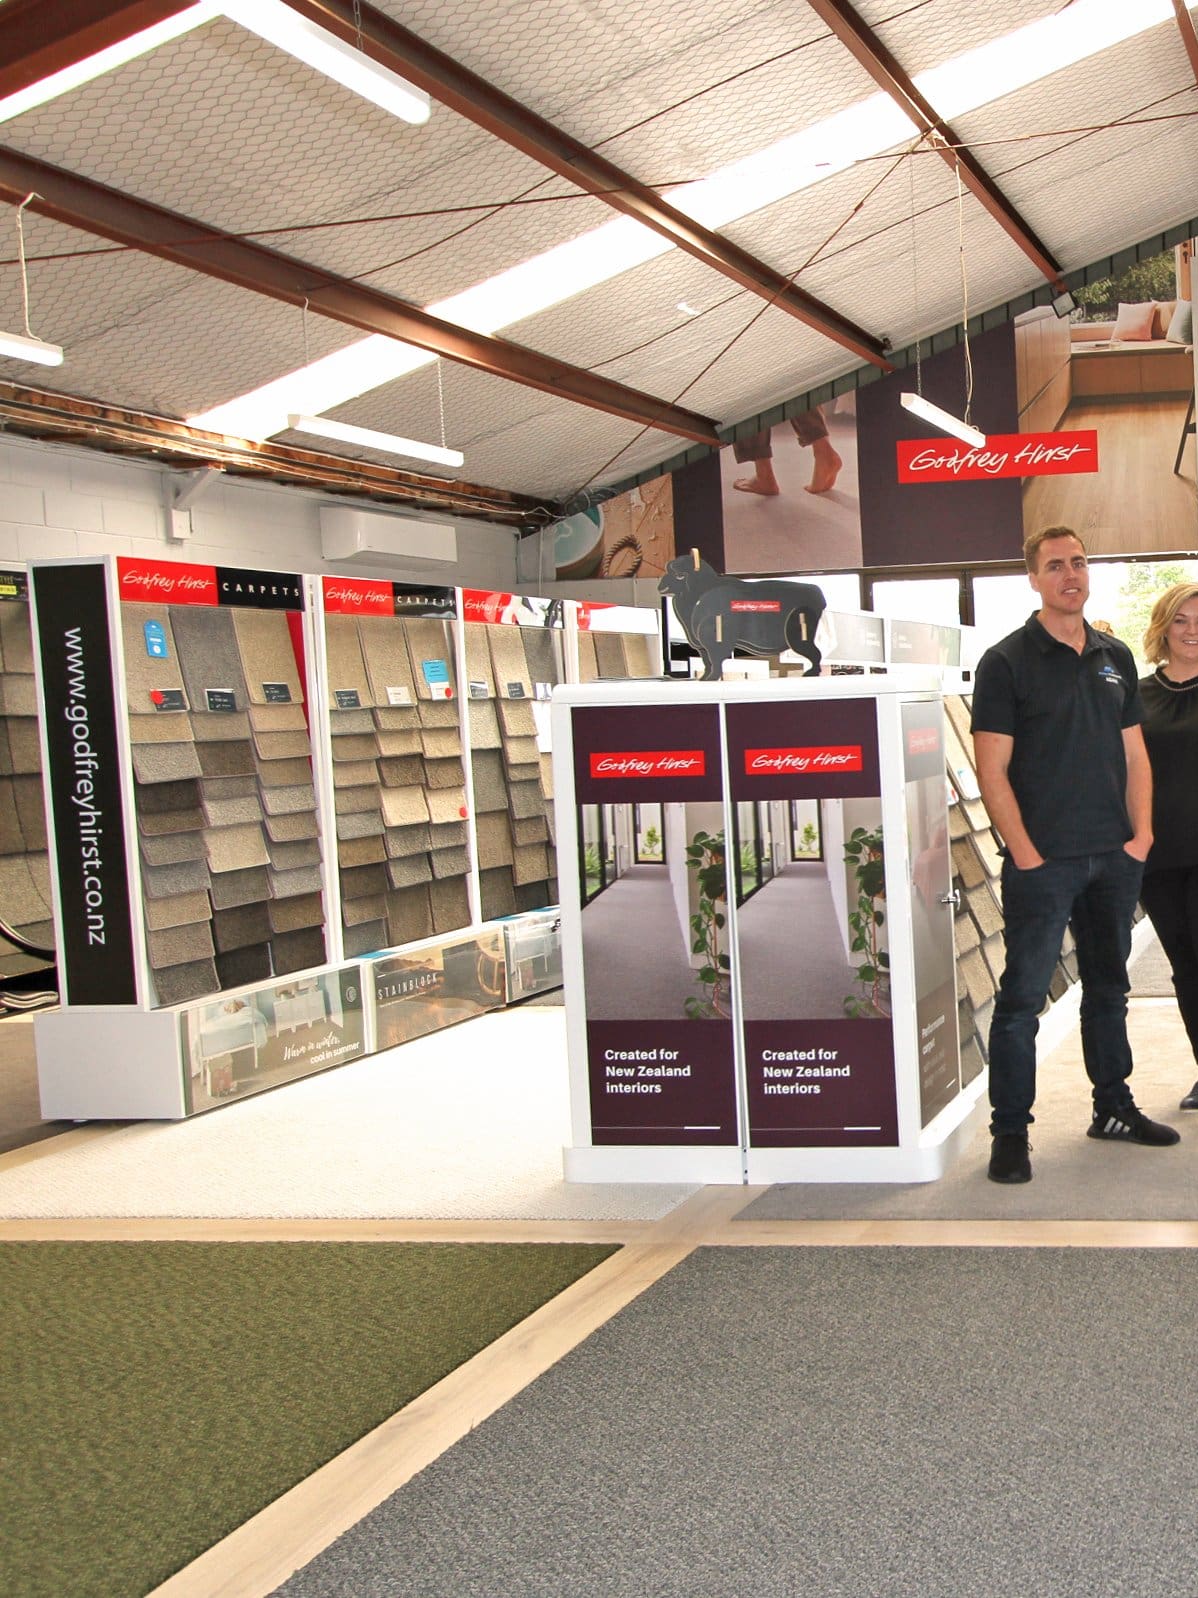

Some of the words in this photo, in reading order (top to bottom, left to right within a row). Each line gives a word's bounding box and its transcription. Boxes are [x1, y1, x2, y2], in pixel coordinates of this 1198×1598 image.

[908, 448, 1009, 475] Godfrey
[1014, 442, 1091, 465] Hirst
[122, 570, 175, 593] Godfrey
[177, 575, 215, 590] Hirst
[222, 582, 300, 597] CARPETS
[325, 586, 363, 606] Godfrey
[364, 589, 392, 603] Hirst
[397, 596, 454, 607] CARPETS
[597, 757, 653, 774] Godfrey
[656, 756, 700, 770] Hirst
[752, 754, 809, 770] Godfrey
[812, 752, 858, 766] Hirst
[64, 626, 106, 946] www.godfreyhirst.co.nz
[377, 972, 438, 1000] STAINBLOCK
[310, 1050, 326, 1065] cool
[326, 1049, 333, 1059] in
[333, 1041, 361, 1057] summer
[604, 1049, 657, 1061] Created
[659, 1048, 679, 1060] for
[762, 1049, 816, 1061] Created
[817, 1048, 838, 1061] for
[605, 1066, 635, 1077] New
[637, 1065, 691, 1077] Zealand
[763, 1066, 793, 1078] New
[796, 1065, 851, 1077] Zealand
[606, 1081, 662, 1094] interiors
[764, 1083, 821, 1095] interiors
